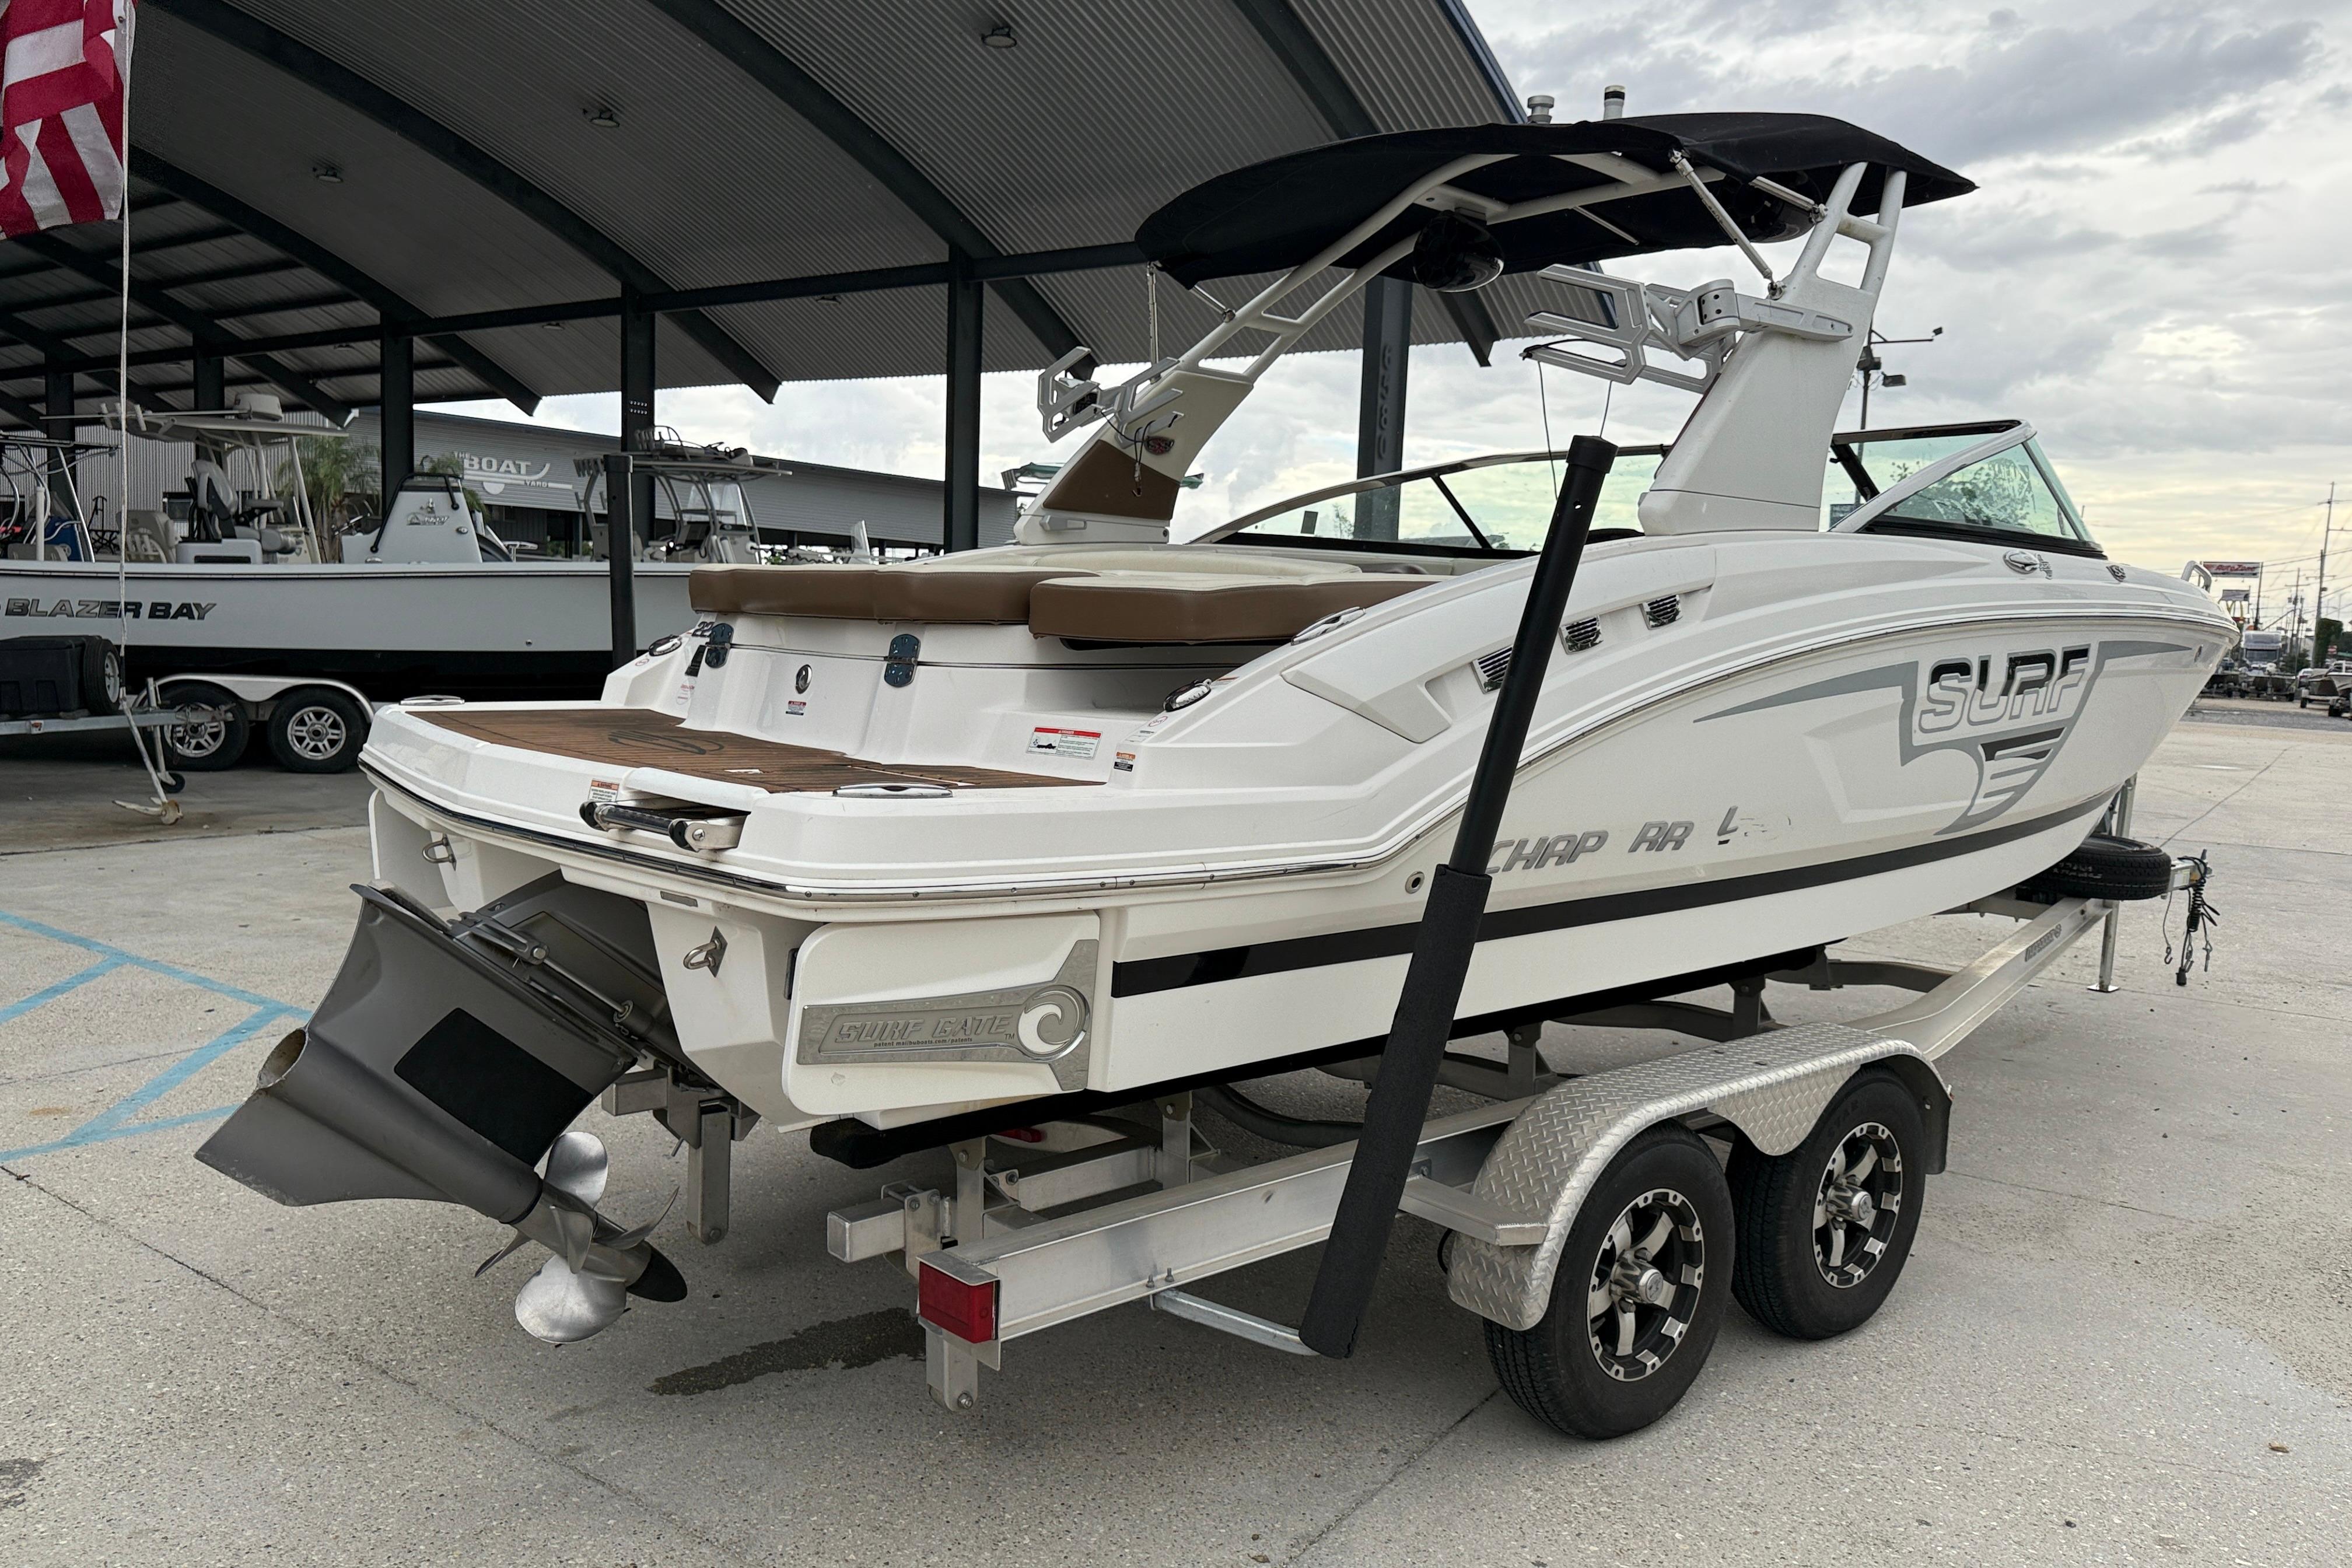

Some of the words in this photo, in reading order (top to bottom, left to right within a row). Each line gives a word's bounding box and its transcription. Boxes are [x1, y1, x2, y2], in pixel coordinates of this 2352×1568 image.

[464, 456, 531, 474] BOAT
[5, 598, 142, 619] BLAZER
[148, 601, 217, 621] BAY
[1919, 643, 2092, 733] SURF
[835, 1019, 925, 1044] SURF
[932, 1013, 1013, 1038] GATE
[1004, 1032, 1016, 1041] TM
